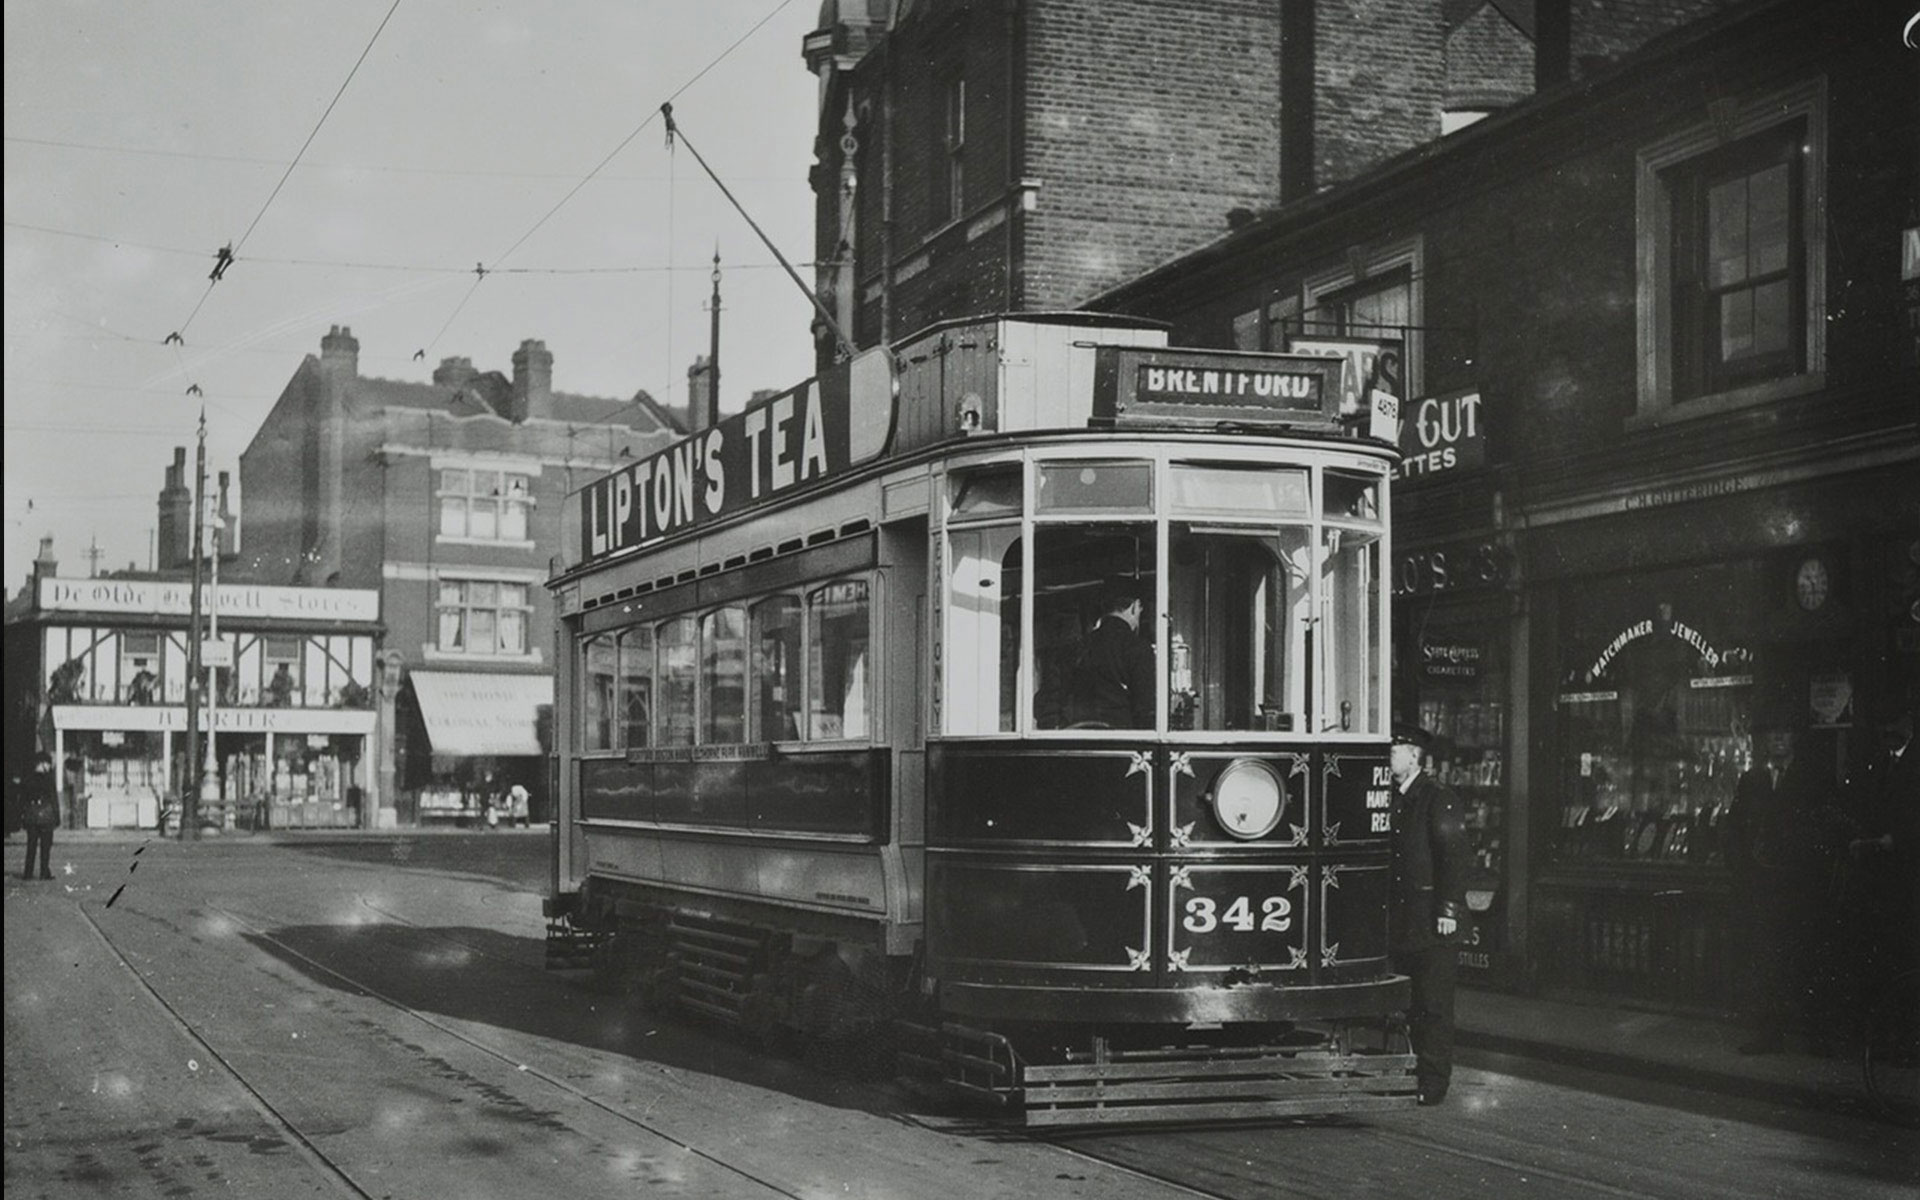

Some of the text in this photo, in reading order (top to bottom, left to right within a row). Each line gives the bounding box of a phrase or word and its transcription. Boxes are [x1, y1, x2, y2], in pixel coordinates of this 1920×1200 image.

[1147, 368, 1310, 397] BRENTFORD
[1416, 393, 1481, 448] CUT
[591, 380, 828, 556] LIPTON'S TEA
[1591, 619, 1653, 677] WATCHMAKER
[1670, 621, 1719, 668] JEWELLER
[933, 641, 943, 727] ONLY
[1366, 790, 1391, 809] HAVE
[1373, 766, 1392, 786] PLE
[1183, 897, 1292, 932] 342
